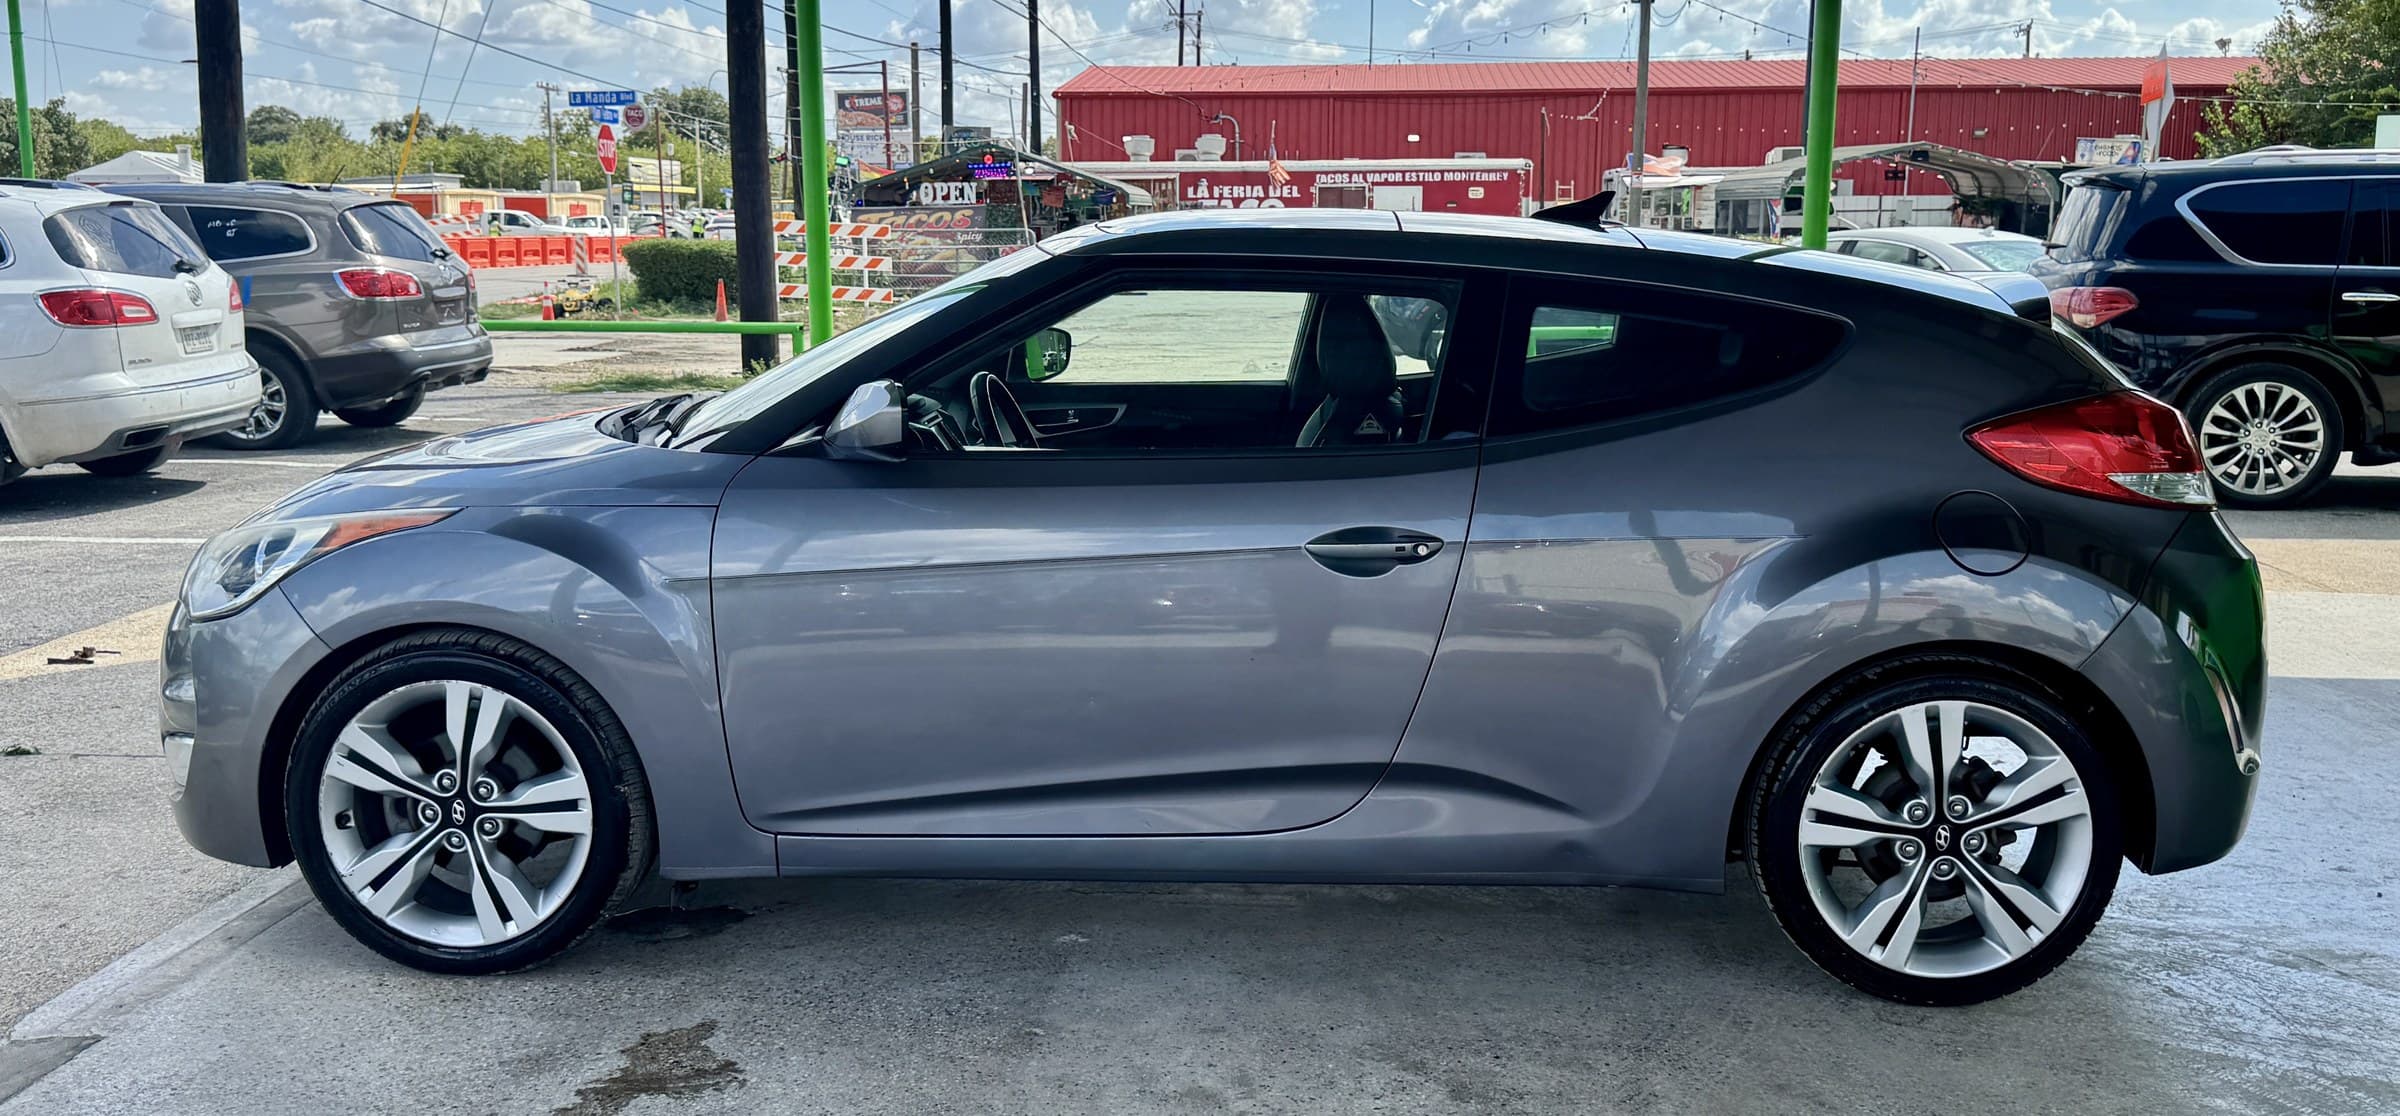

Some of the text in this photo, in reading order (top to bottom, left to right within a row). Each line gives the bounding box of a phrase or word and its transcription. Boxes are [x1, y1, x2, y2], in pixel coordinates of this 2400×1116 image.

[570, 92, 582, 104] La
[599, 139, 616, 158] STOP
[1316, 171, 1509, 183] TACOS AL VAPOR ESTILO MONTERREY
[920, 182, 977, 205] OPEN
[1213, 185, 1265, 198] FERIA
[1268, 185, 1301, 198] DEL
